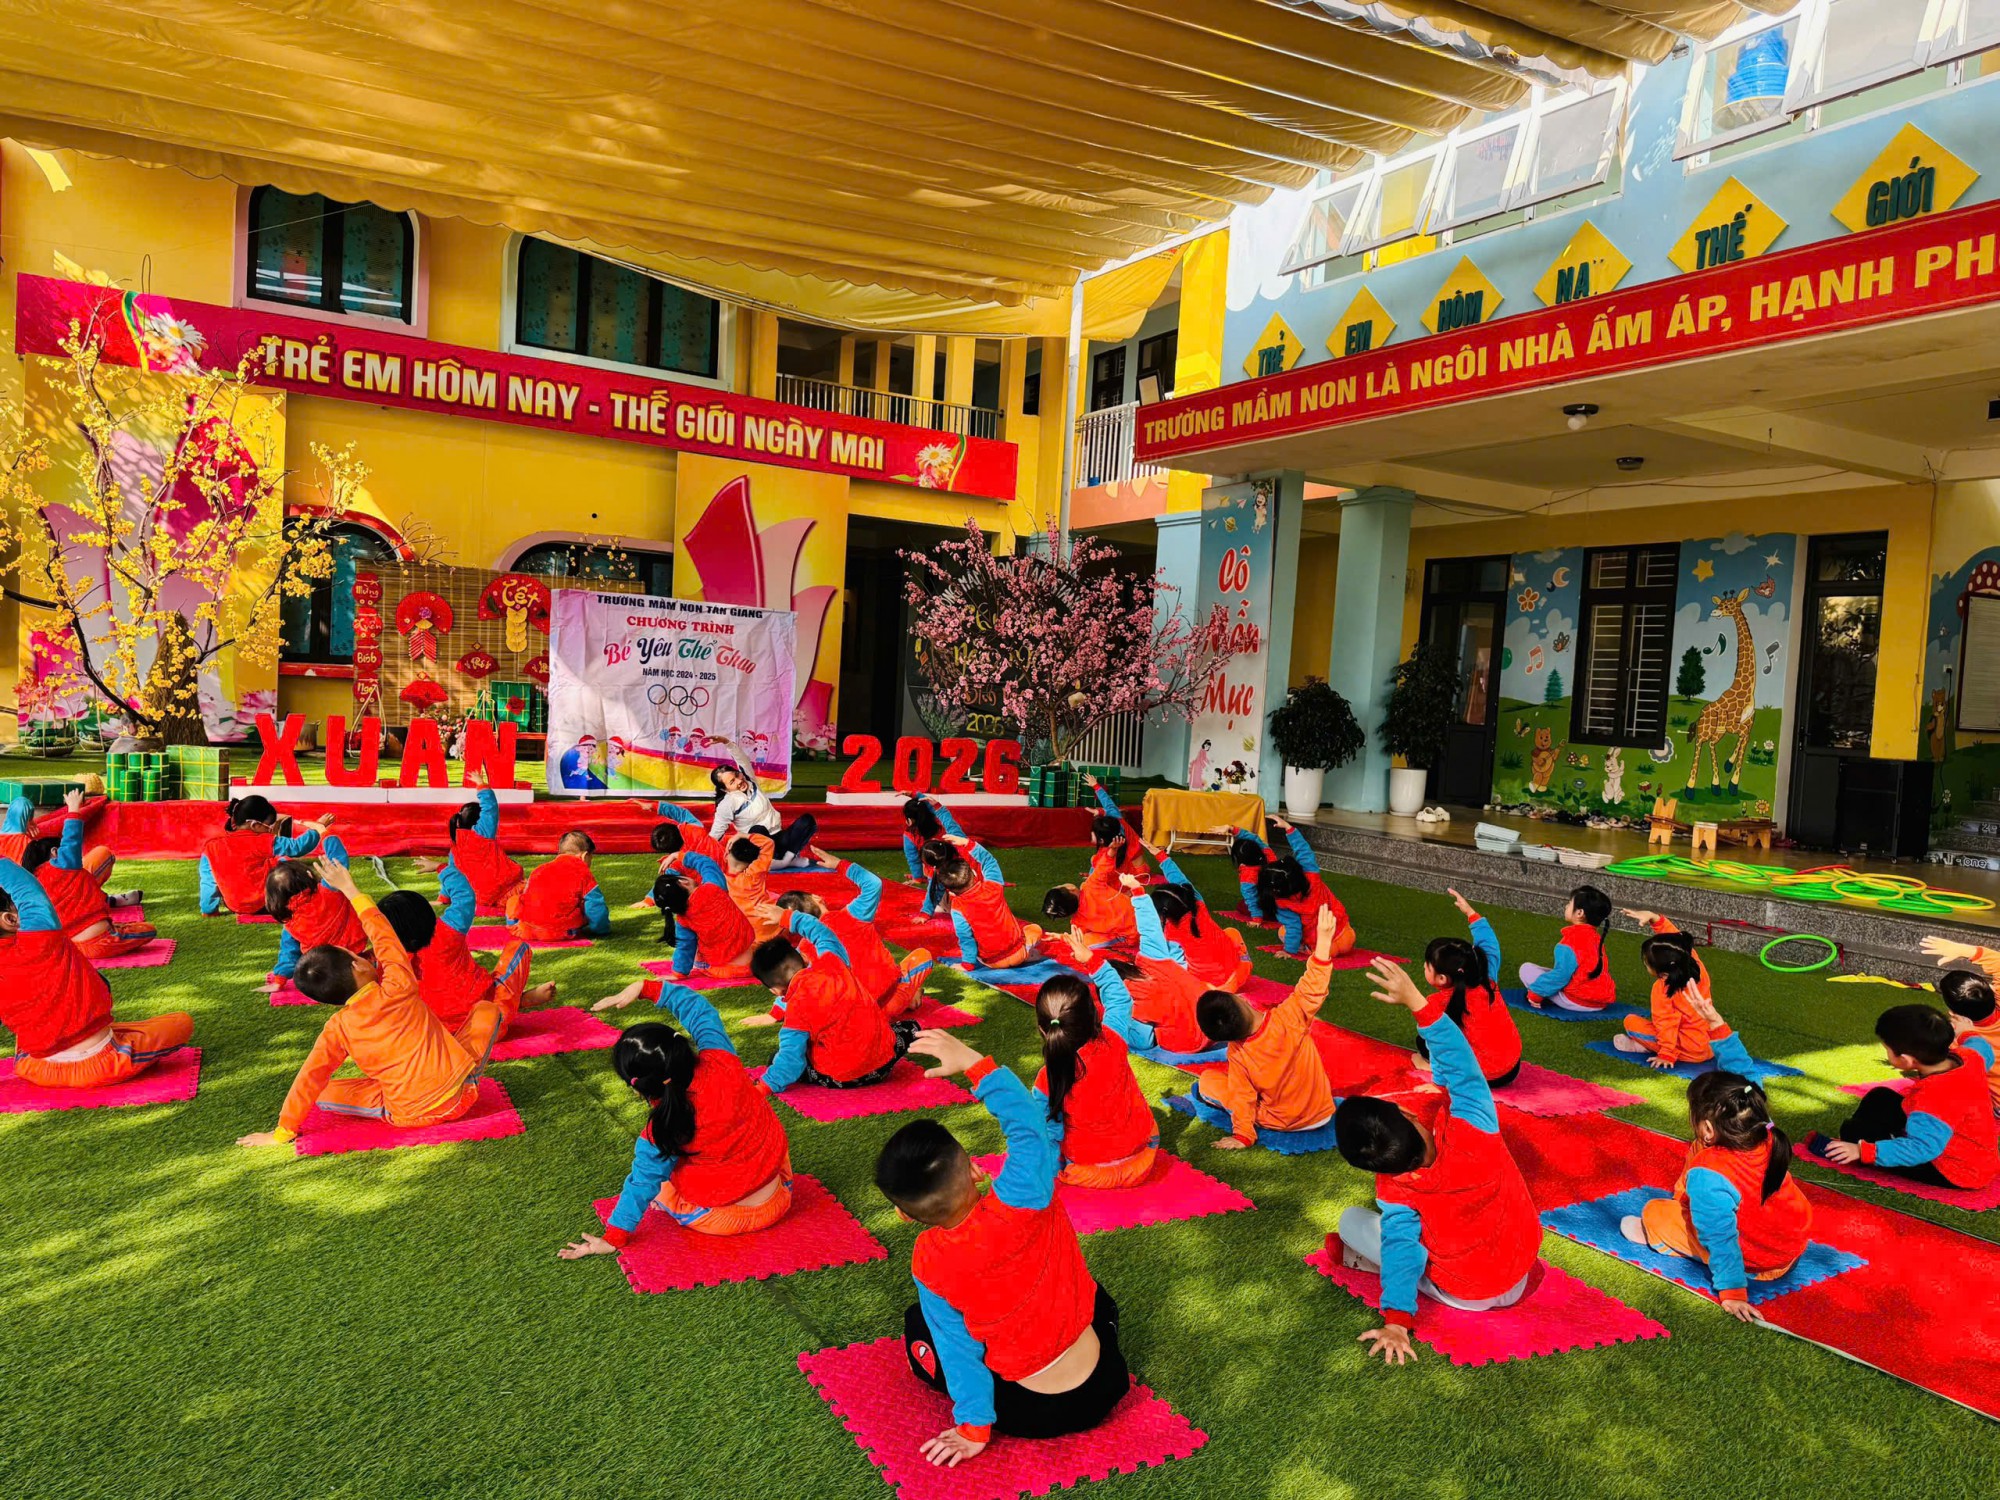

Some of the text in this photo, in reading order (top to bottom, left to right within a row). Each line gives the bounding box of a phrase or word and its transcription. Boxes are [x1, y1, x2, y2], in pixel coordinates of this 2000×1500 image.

[1257, 330, 1286, 378] TRẺ
[1345, 320, 1373, 357] EM
[1437, 290, 1484, 333] HÔM
[1695, 203, 1753, 270] THẾ
[1866, 156, 1936, 227] GIỚI
[1144, 233, 2000, 445] TRƯỜNG MẦM NON LÀ NGÔI NHÀ ẤM ÁP, HẠNH PH
[261, 335, 331, 384] TRẺ
[343, 350, 401, 394] EM
[413, 358, 497, 408] HÔM
[508, 376, 580, 420] NAY
[609, 389, 671, 435] THẾ
[676, 404, 736, 447] GIỚI
[744, 417, 822, 460] NGÀY
[831, 431, 884, 471] MAI
[1218, 545, 1251, 593] Cô
[502, 579, 540, 608] Tết
[597, 594, 645, 608] TRƯỜNG
[680, 602, 703, 614] NON
[730, 607, 763, 619] GIANG
[626, 615, 735, 635] CHƯƠNG TRÌNH
[604, 637, 757, 675] Bé Yêu Thể Thao
[642, 667, 660, 677] NĂM
[661, 668, 675, 679] HỌC
[676, 670, 694, 679] 2024
[699, 672, 717, 681] 2025
[1201, 668, 1255, 731] Mực
[841, 734, 1021, 795] 2026
[1962, 857, 1987, 869] one
